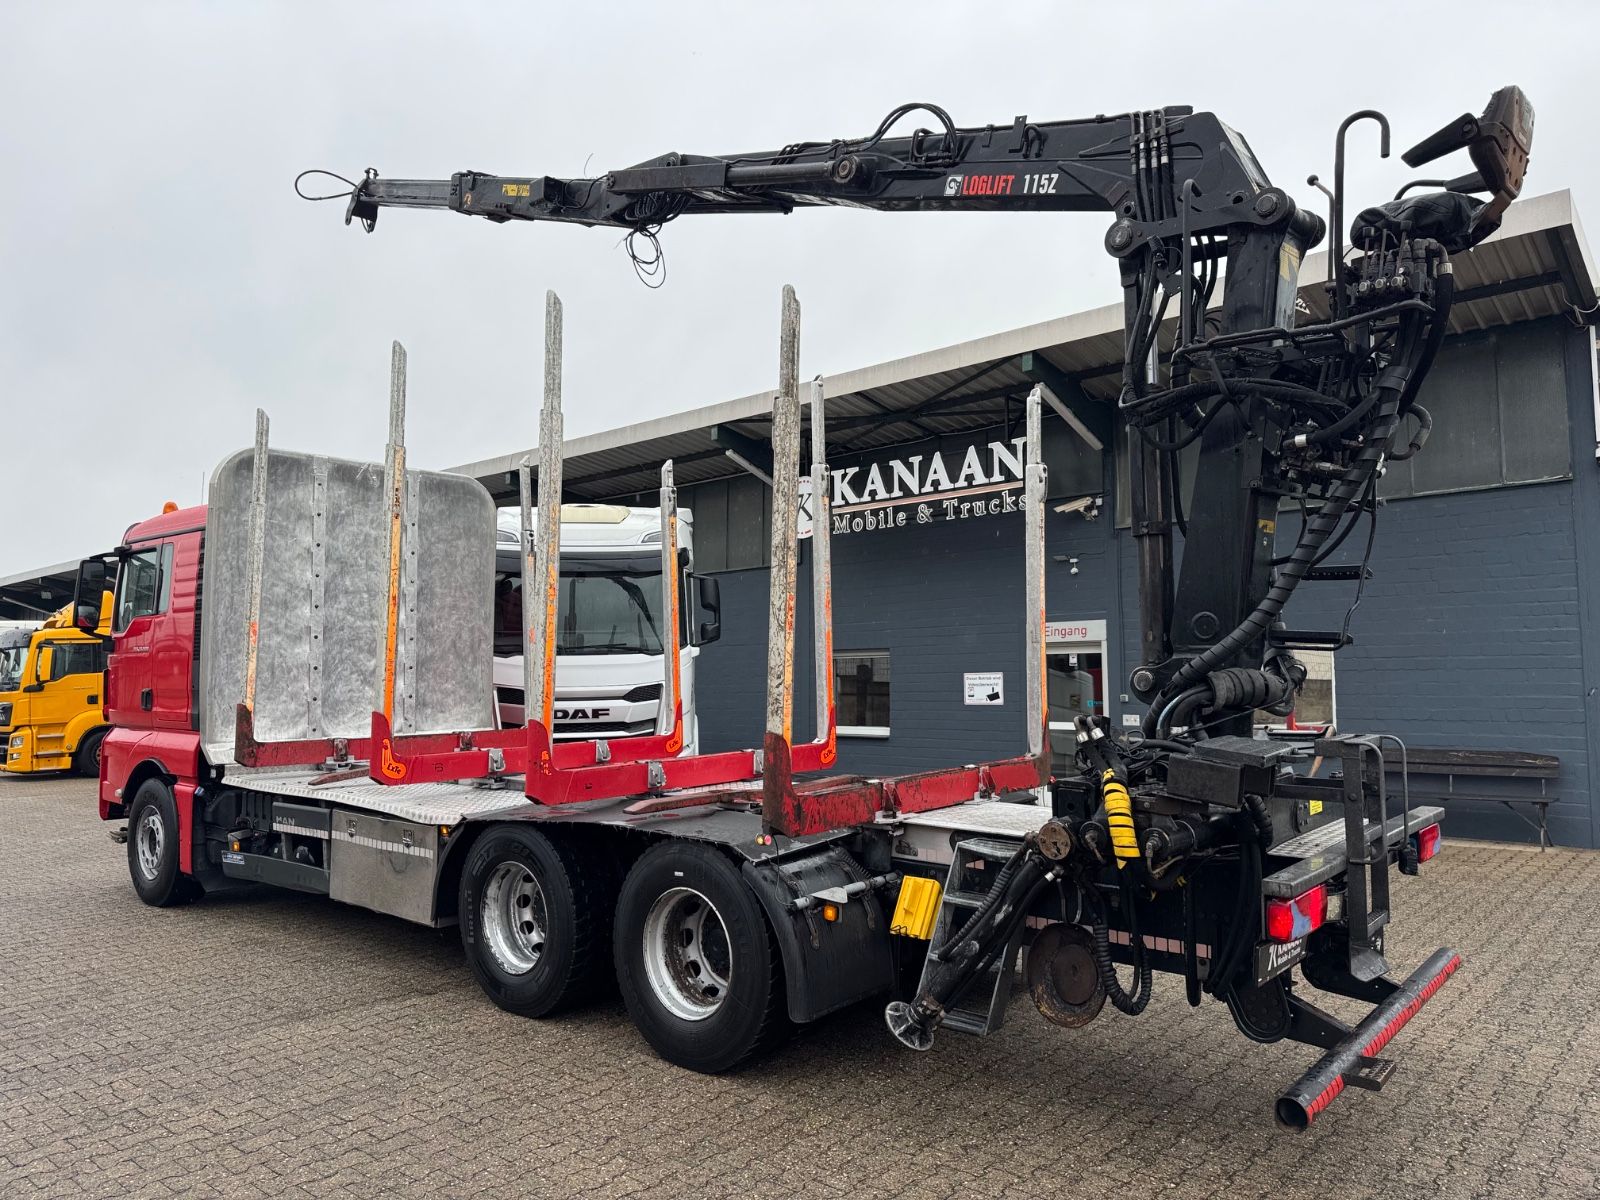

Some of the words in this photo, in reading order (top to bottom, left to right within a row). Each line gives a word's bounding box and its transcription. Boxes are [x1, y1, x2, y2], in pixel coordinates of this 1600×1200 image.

[962, 174, 1016, 196] LOGLIFT
[1023, 173, 1060, 194] 115Z
[831, 436, 1027, 506] KANAAN
[832, 506, 907, 535] Mobile
[916, 503, 933, 524] &
[943, 490, 1027, 521] Trucks
[1045, 625, 1088, 639] Eingang
[553, 708, 610, 720] DAF
[276, 815, 295, 826] MAN
